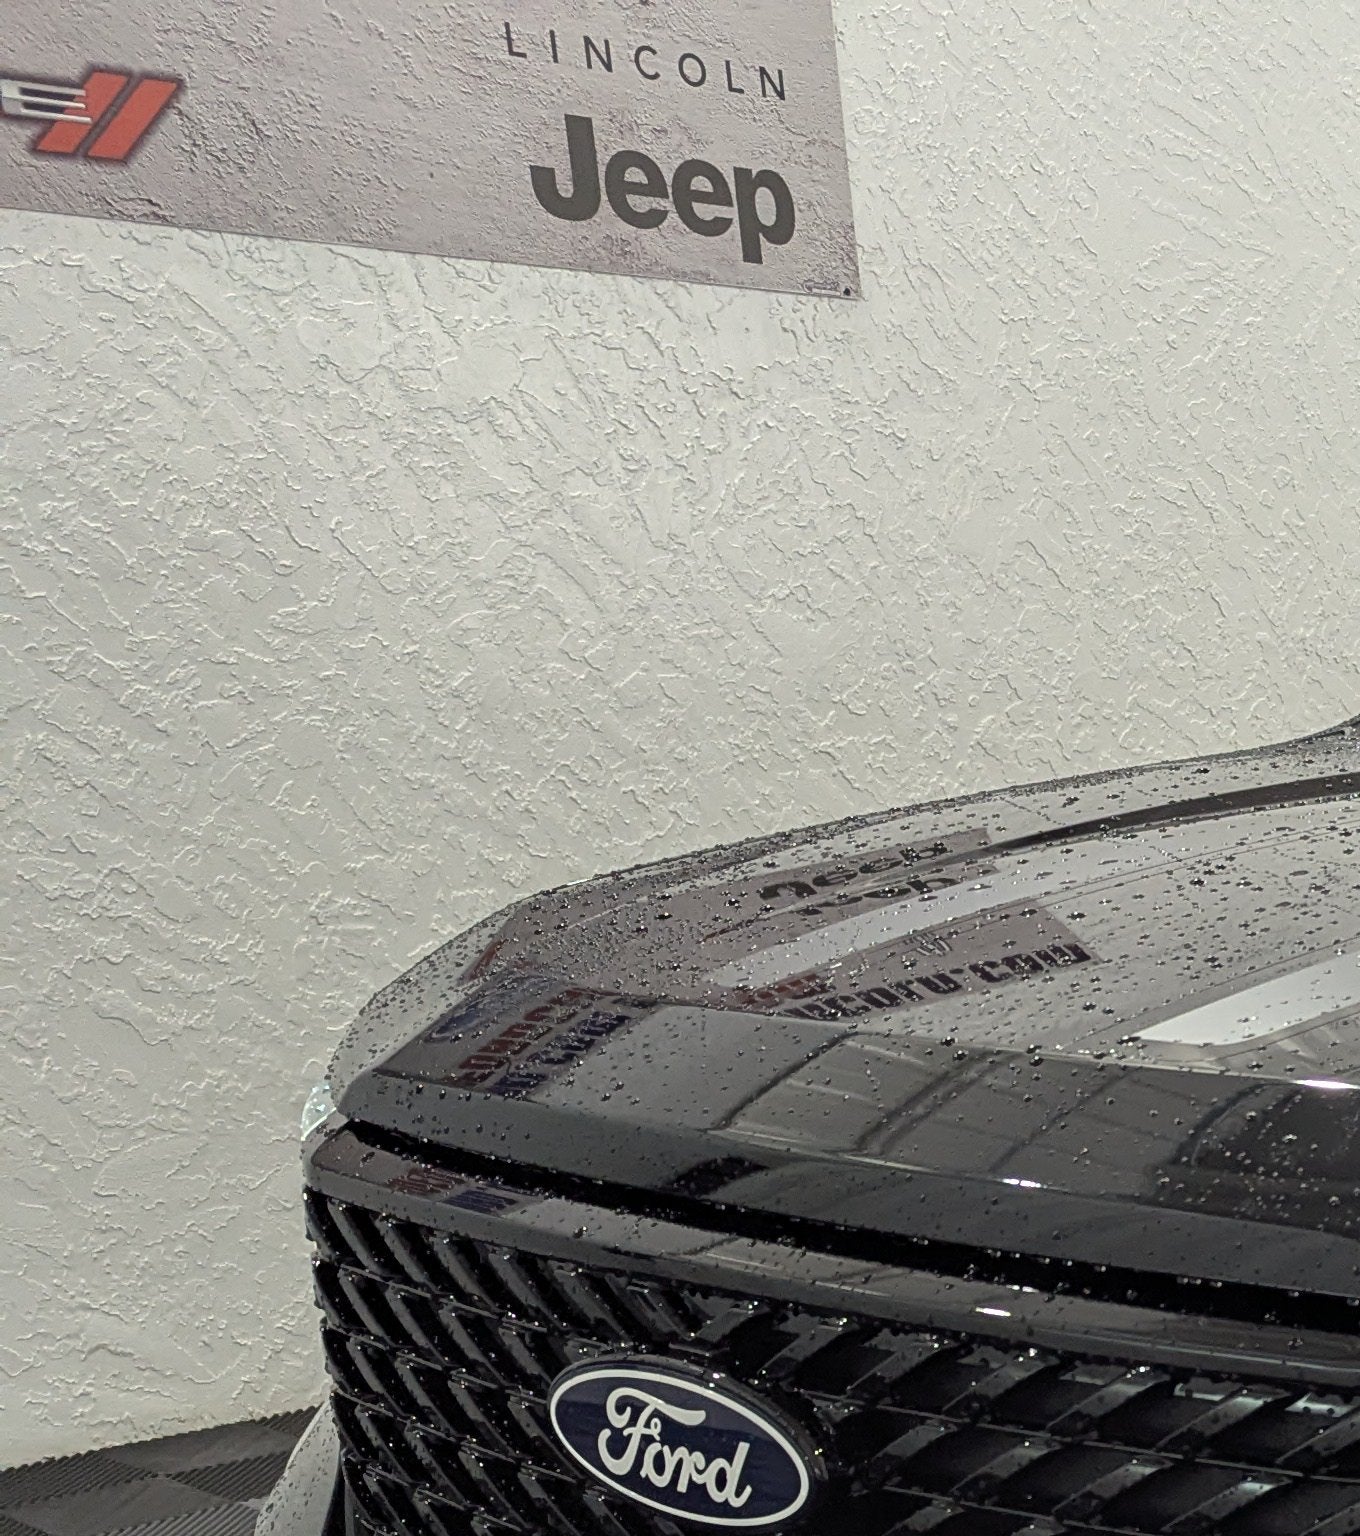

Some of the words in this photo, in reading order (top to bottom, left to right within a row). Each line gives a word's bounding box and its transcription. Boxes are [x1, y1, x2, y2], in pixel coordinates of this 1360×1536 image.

[504, 21, 787, 101] LINCOLN
[529, 113, 796, 265] Jeep
[597, 1386, 752, 1509] Ford
